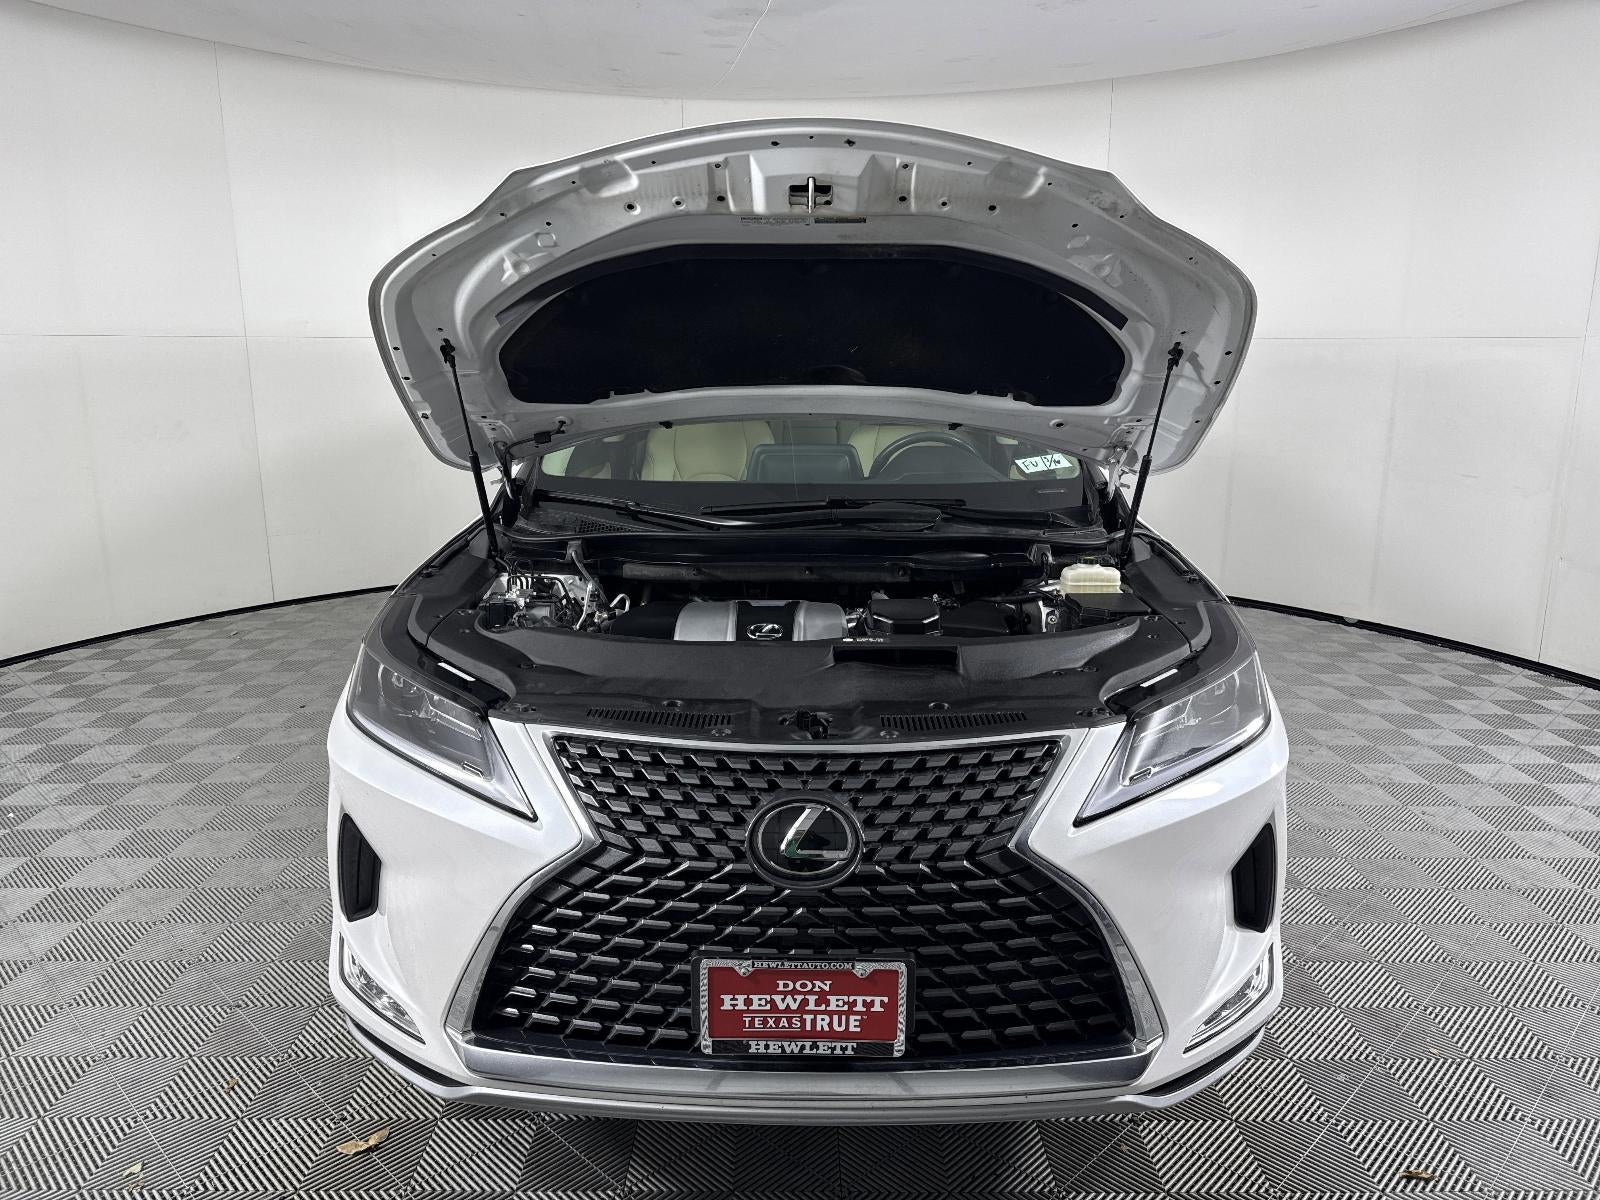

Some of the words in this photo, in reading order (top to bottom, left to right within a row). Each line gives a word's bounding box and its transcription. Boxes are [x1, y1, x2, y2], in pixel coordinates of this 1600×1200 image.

[752, 961, 853, 970] HEWLETTAUTO.COM
[776, 980, 833, 992] DON
[720, 994, 889, 1012] HEWLETT
[748, 1040, 857, 1055] HEWLETT
